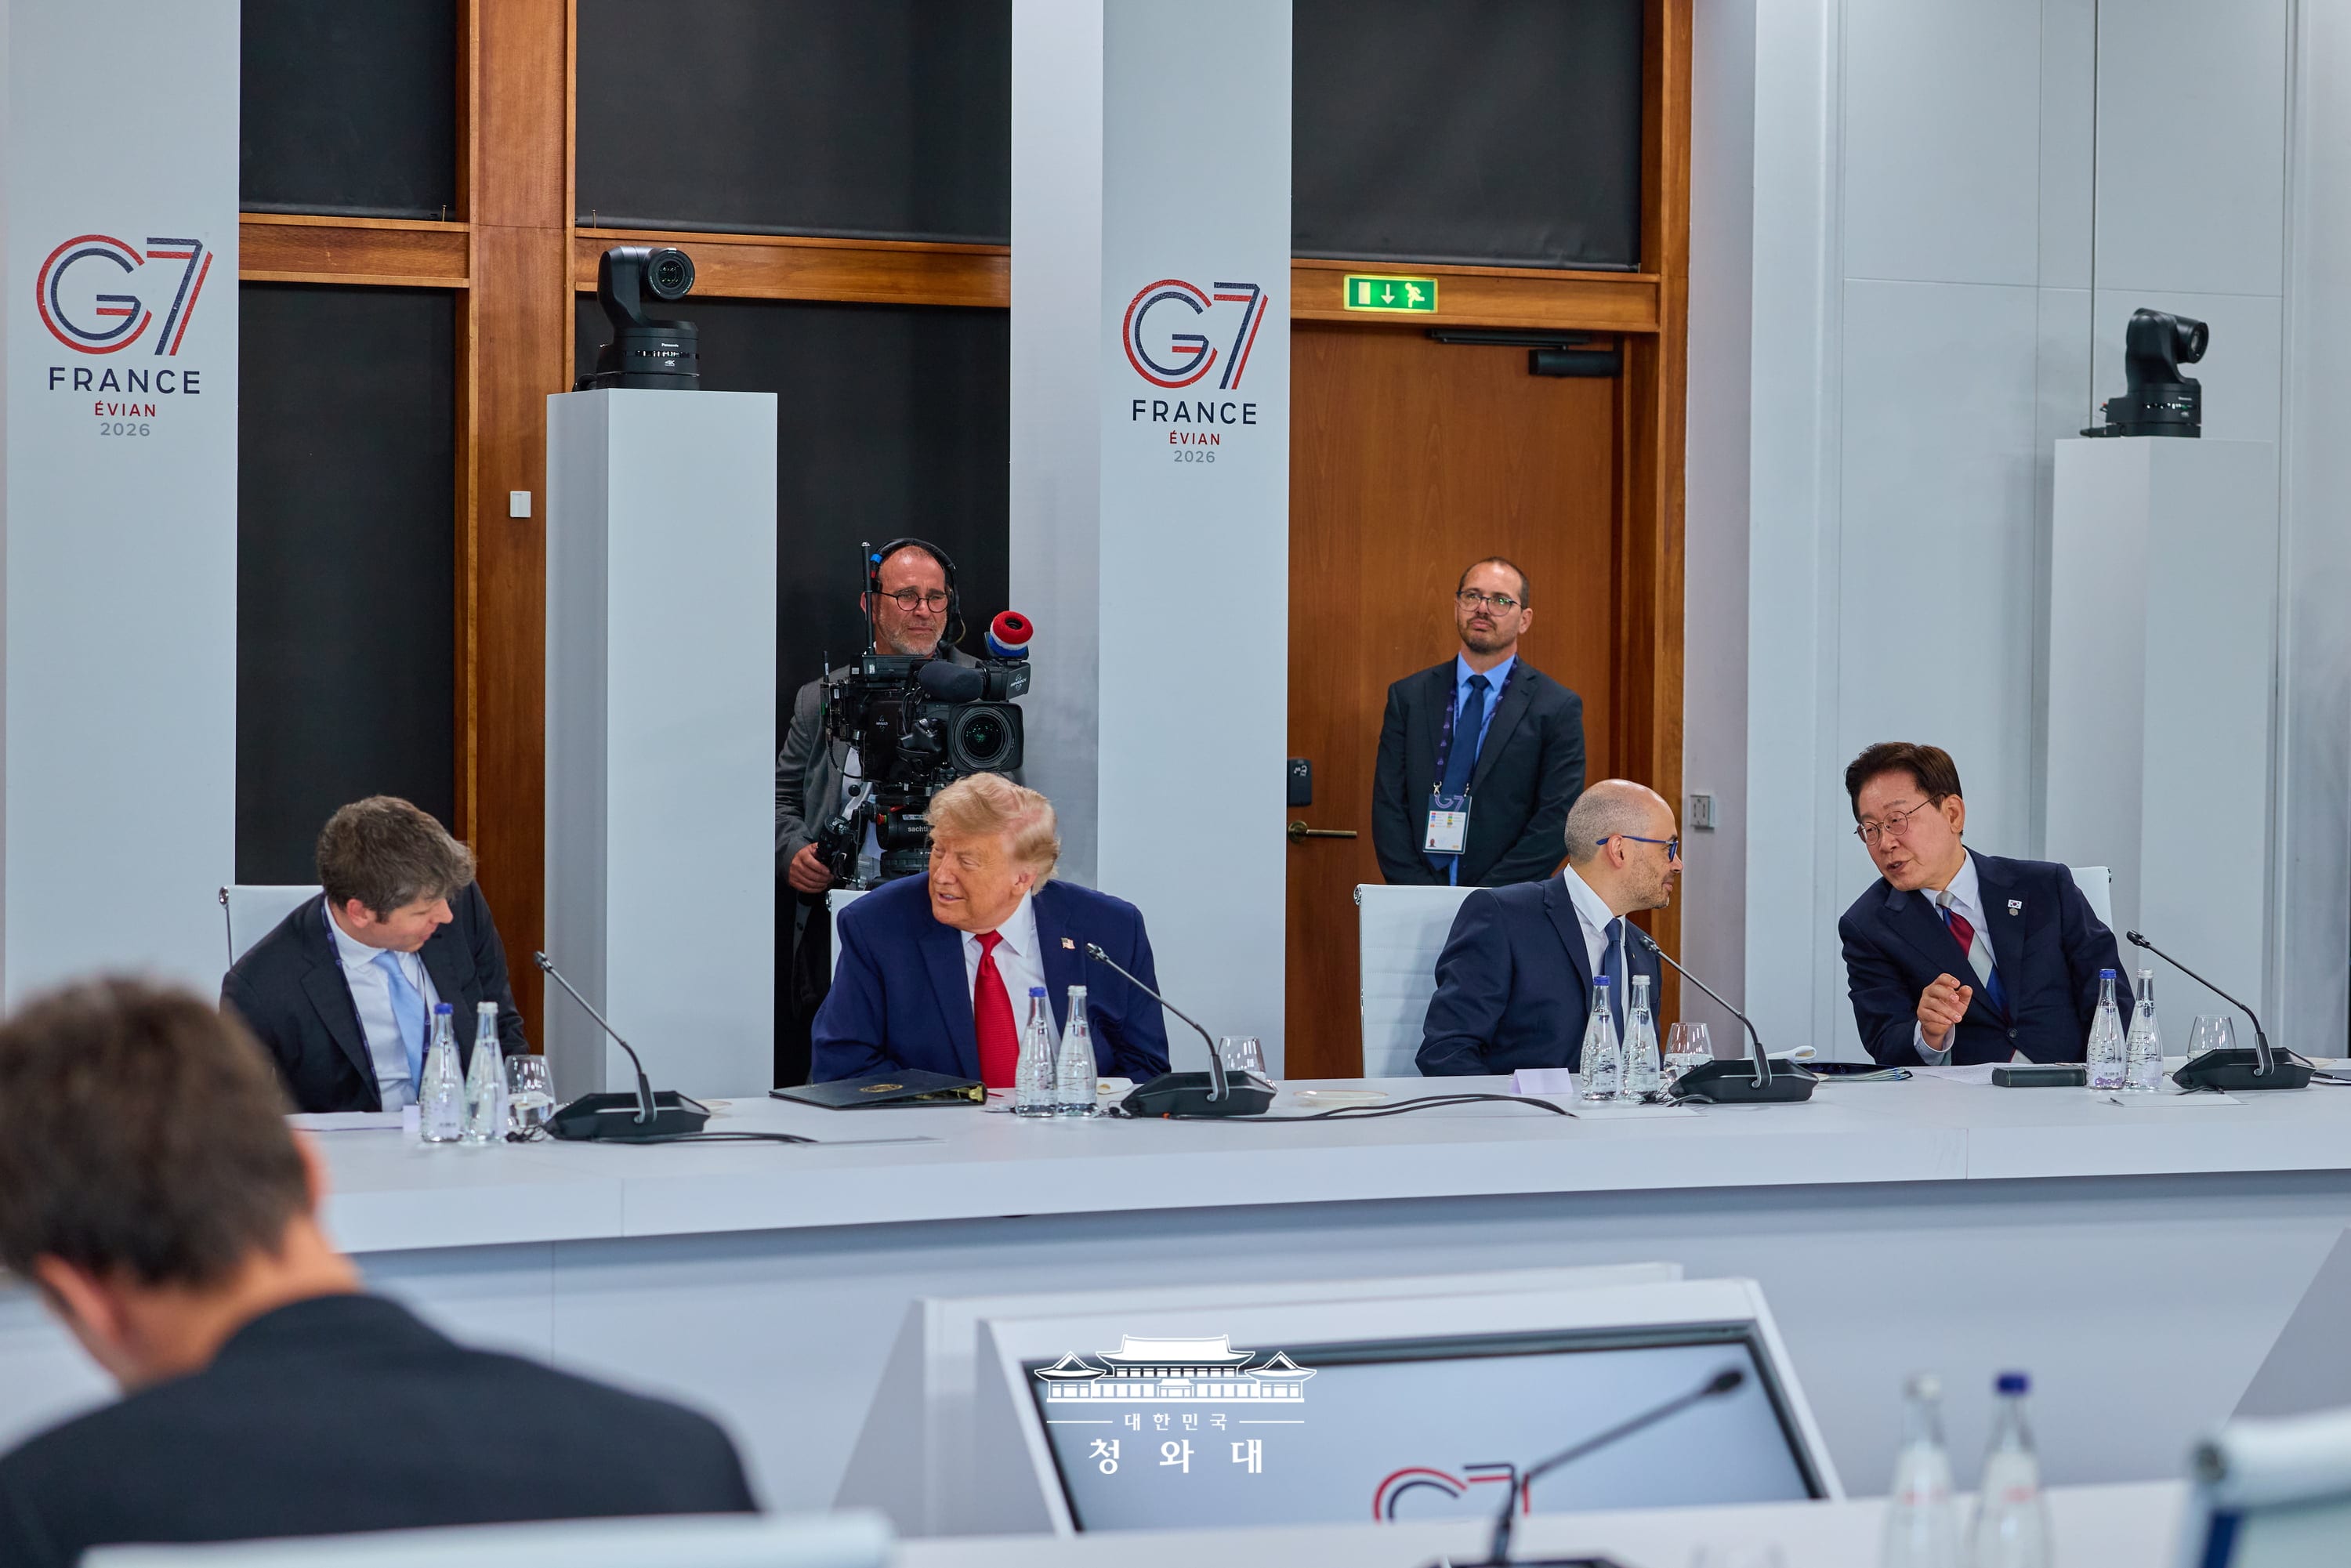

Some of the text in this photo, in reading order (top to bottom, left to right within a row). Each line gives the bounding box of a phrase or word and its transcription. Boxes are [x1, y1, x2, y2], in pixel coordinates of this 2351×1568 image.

[36, 234, 213, 356] G7
[1122, 279, 1269, 389] G7
[49, 367, 201, 394] FRANCE
[95, 400, 156, 417] ÉVIAN
[1132, 400, 1257, 425] FRANCE
[100, 422, 150, 436] 2026
[1169, 429, 1220, 445] ÉVIAN
[1174, 451, 1215, 463] 2026
